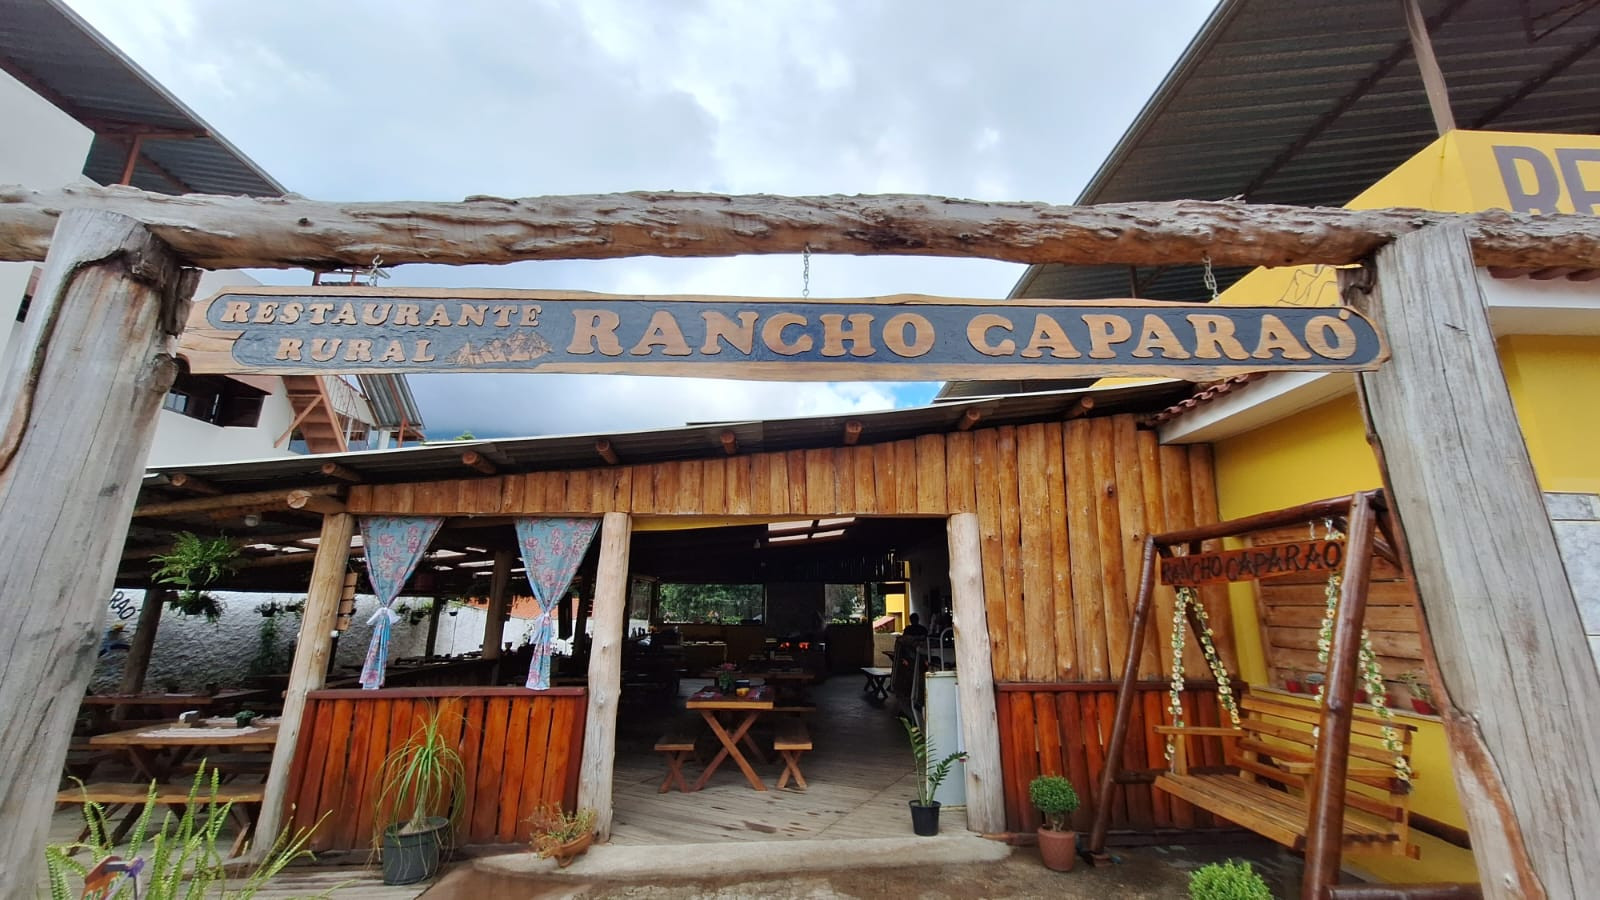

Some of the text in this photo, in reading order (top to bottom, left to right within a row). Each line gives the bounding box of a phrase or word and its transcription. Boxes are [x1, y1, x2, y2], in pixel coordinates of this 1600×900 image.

[220, 300, 543, 328] RESTAURANTE
[566, 308, 936, 358] RANCHO
[275, 337, 436, 363] RURAL
[1162, 555, 1223, 585] RANCHO
